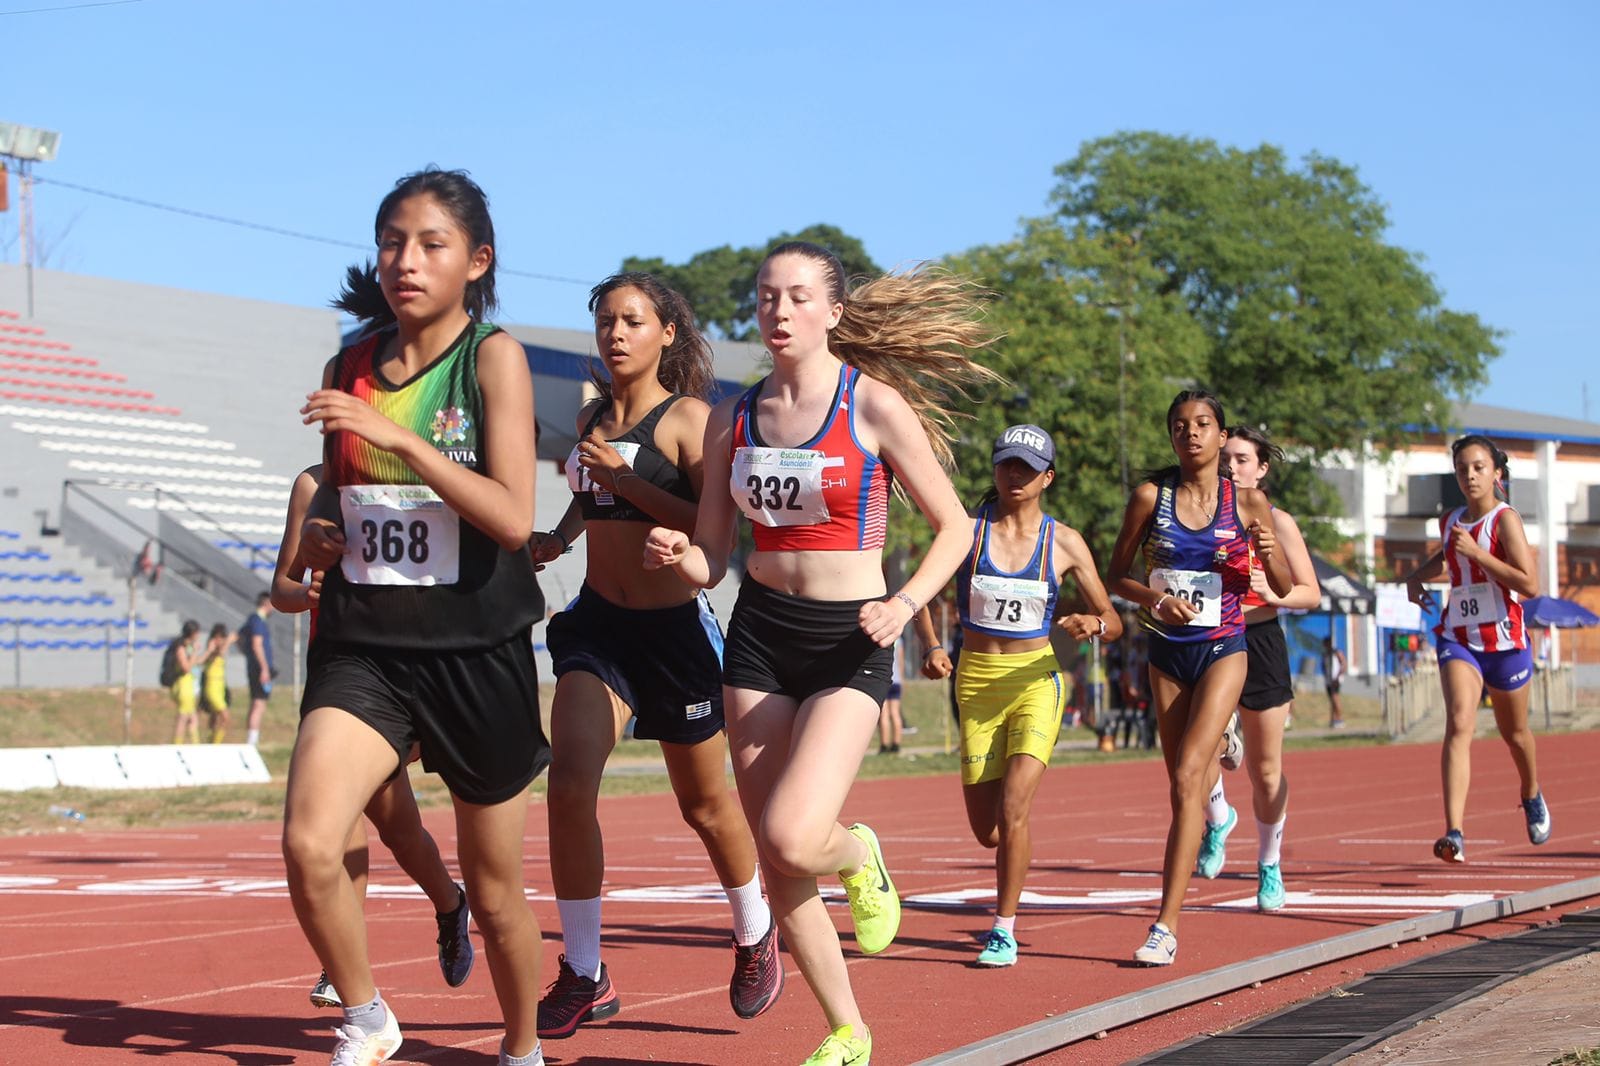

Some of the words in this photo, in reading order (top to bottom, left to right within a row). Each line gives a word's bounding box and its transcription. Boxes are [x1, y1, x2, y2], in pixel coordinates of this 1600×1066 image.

[1004, 429, 1045, 451] VANS
[746, 475, 803, 511] 332
[362, 519, 429, 564] 368
[995, 599, 1022, 622] 73
[1461, 599, 1479, 617] 98
